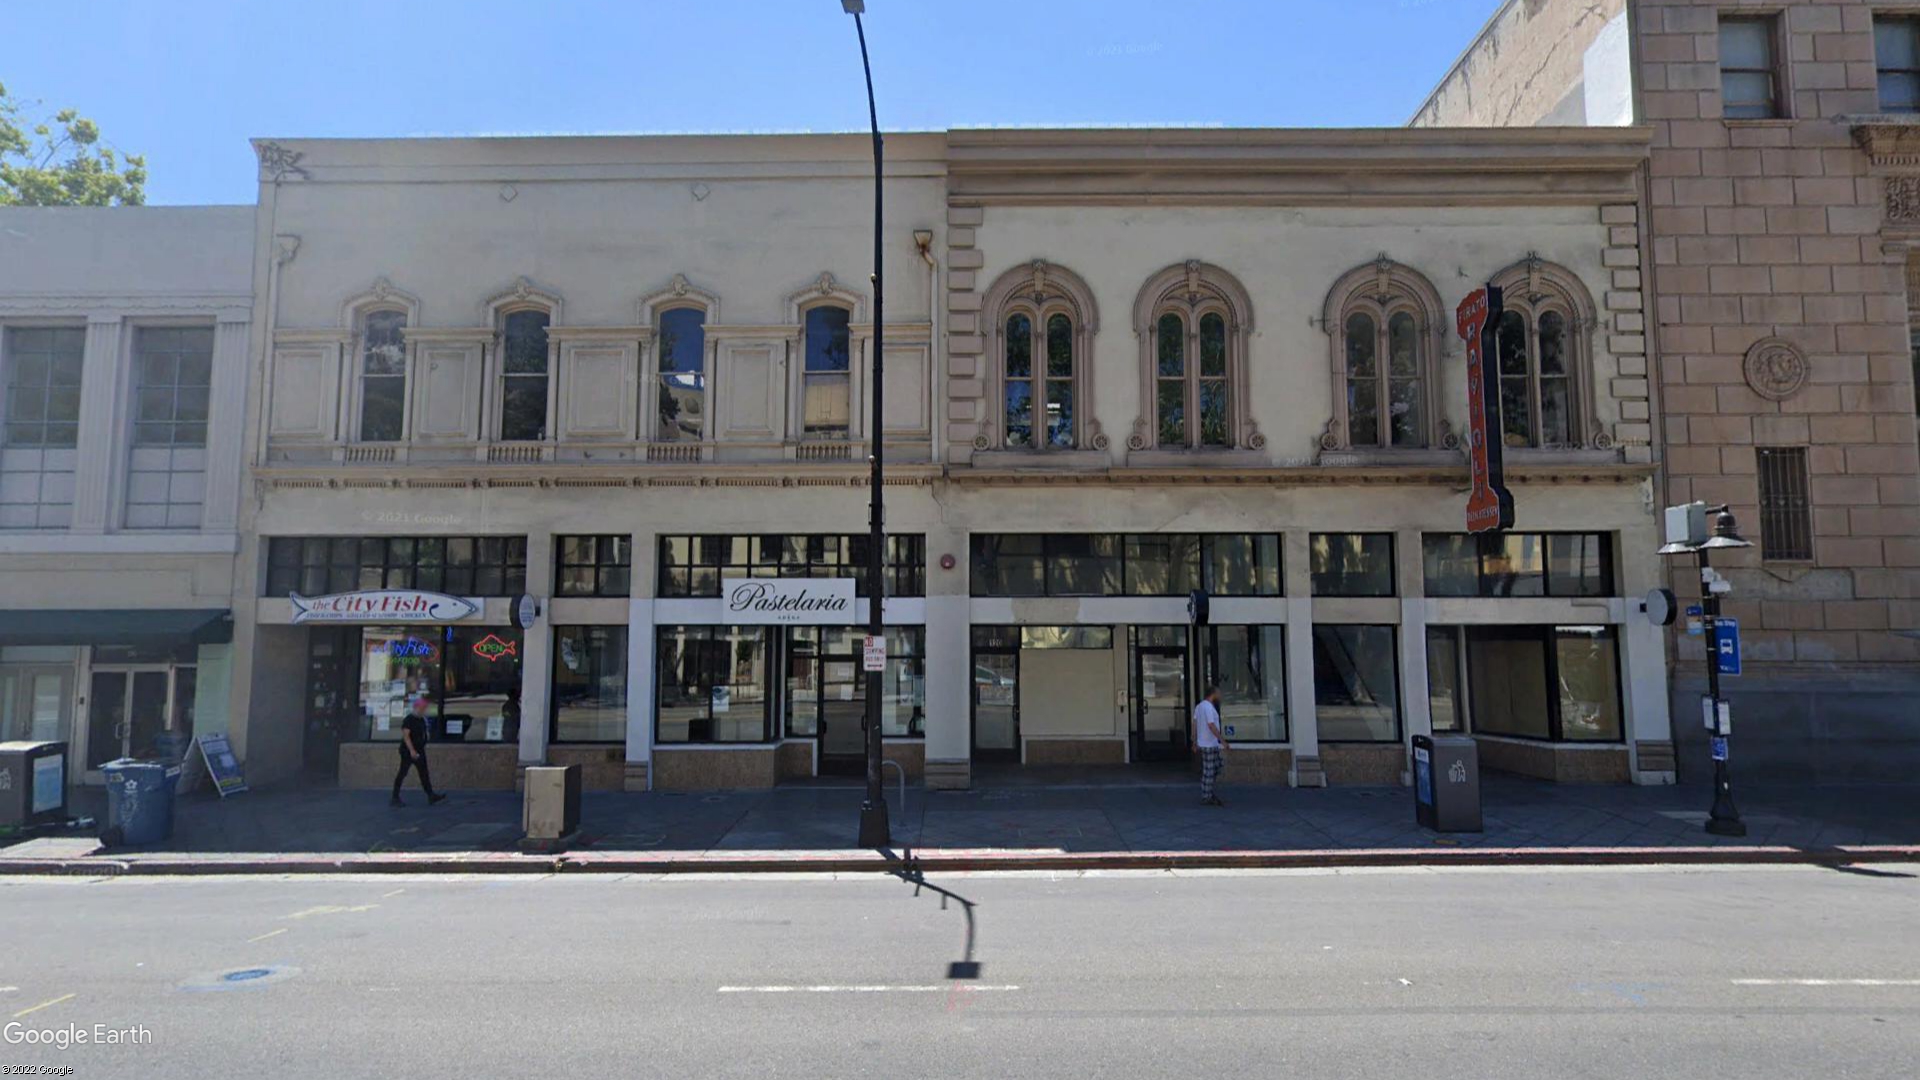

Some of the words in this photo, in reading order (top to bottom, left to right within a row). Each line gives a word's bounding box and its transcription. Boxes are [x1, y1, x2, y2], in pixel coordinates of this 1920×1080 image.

[312, 599, 331, 611] the
[332, 596, 377, 613] City
[380, 595, 428, 612] Fish
[730, 582, 848, 612] Pastelaria
[404, 636, 430, 656] Fish
[479, 643, 504, 653] OPEN
[865, 636, 874, 647] NO
